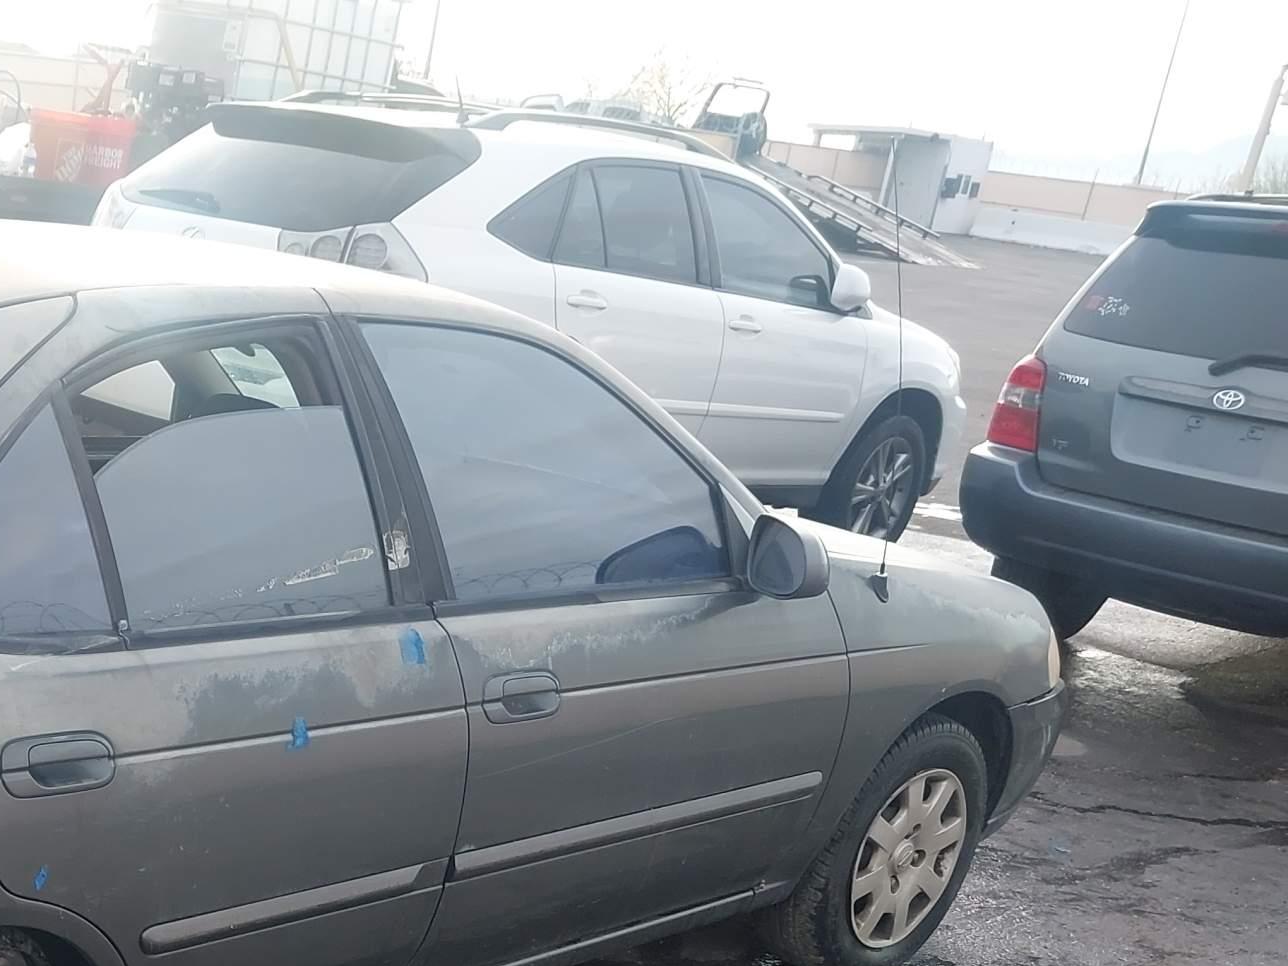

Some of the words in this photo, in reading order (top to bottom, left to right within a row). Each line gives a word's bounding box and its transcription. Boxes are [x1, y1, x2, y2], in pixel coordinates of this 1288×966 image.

[85, 144, 124, 161] HARBOR
[84, 154, 122, 169] FREIGHT
[1058, 371, 1089, 386] TOYOTA
